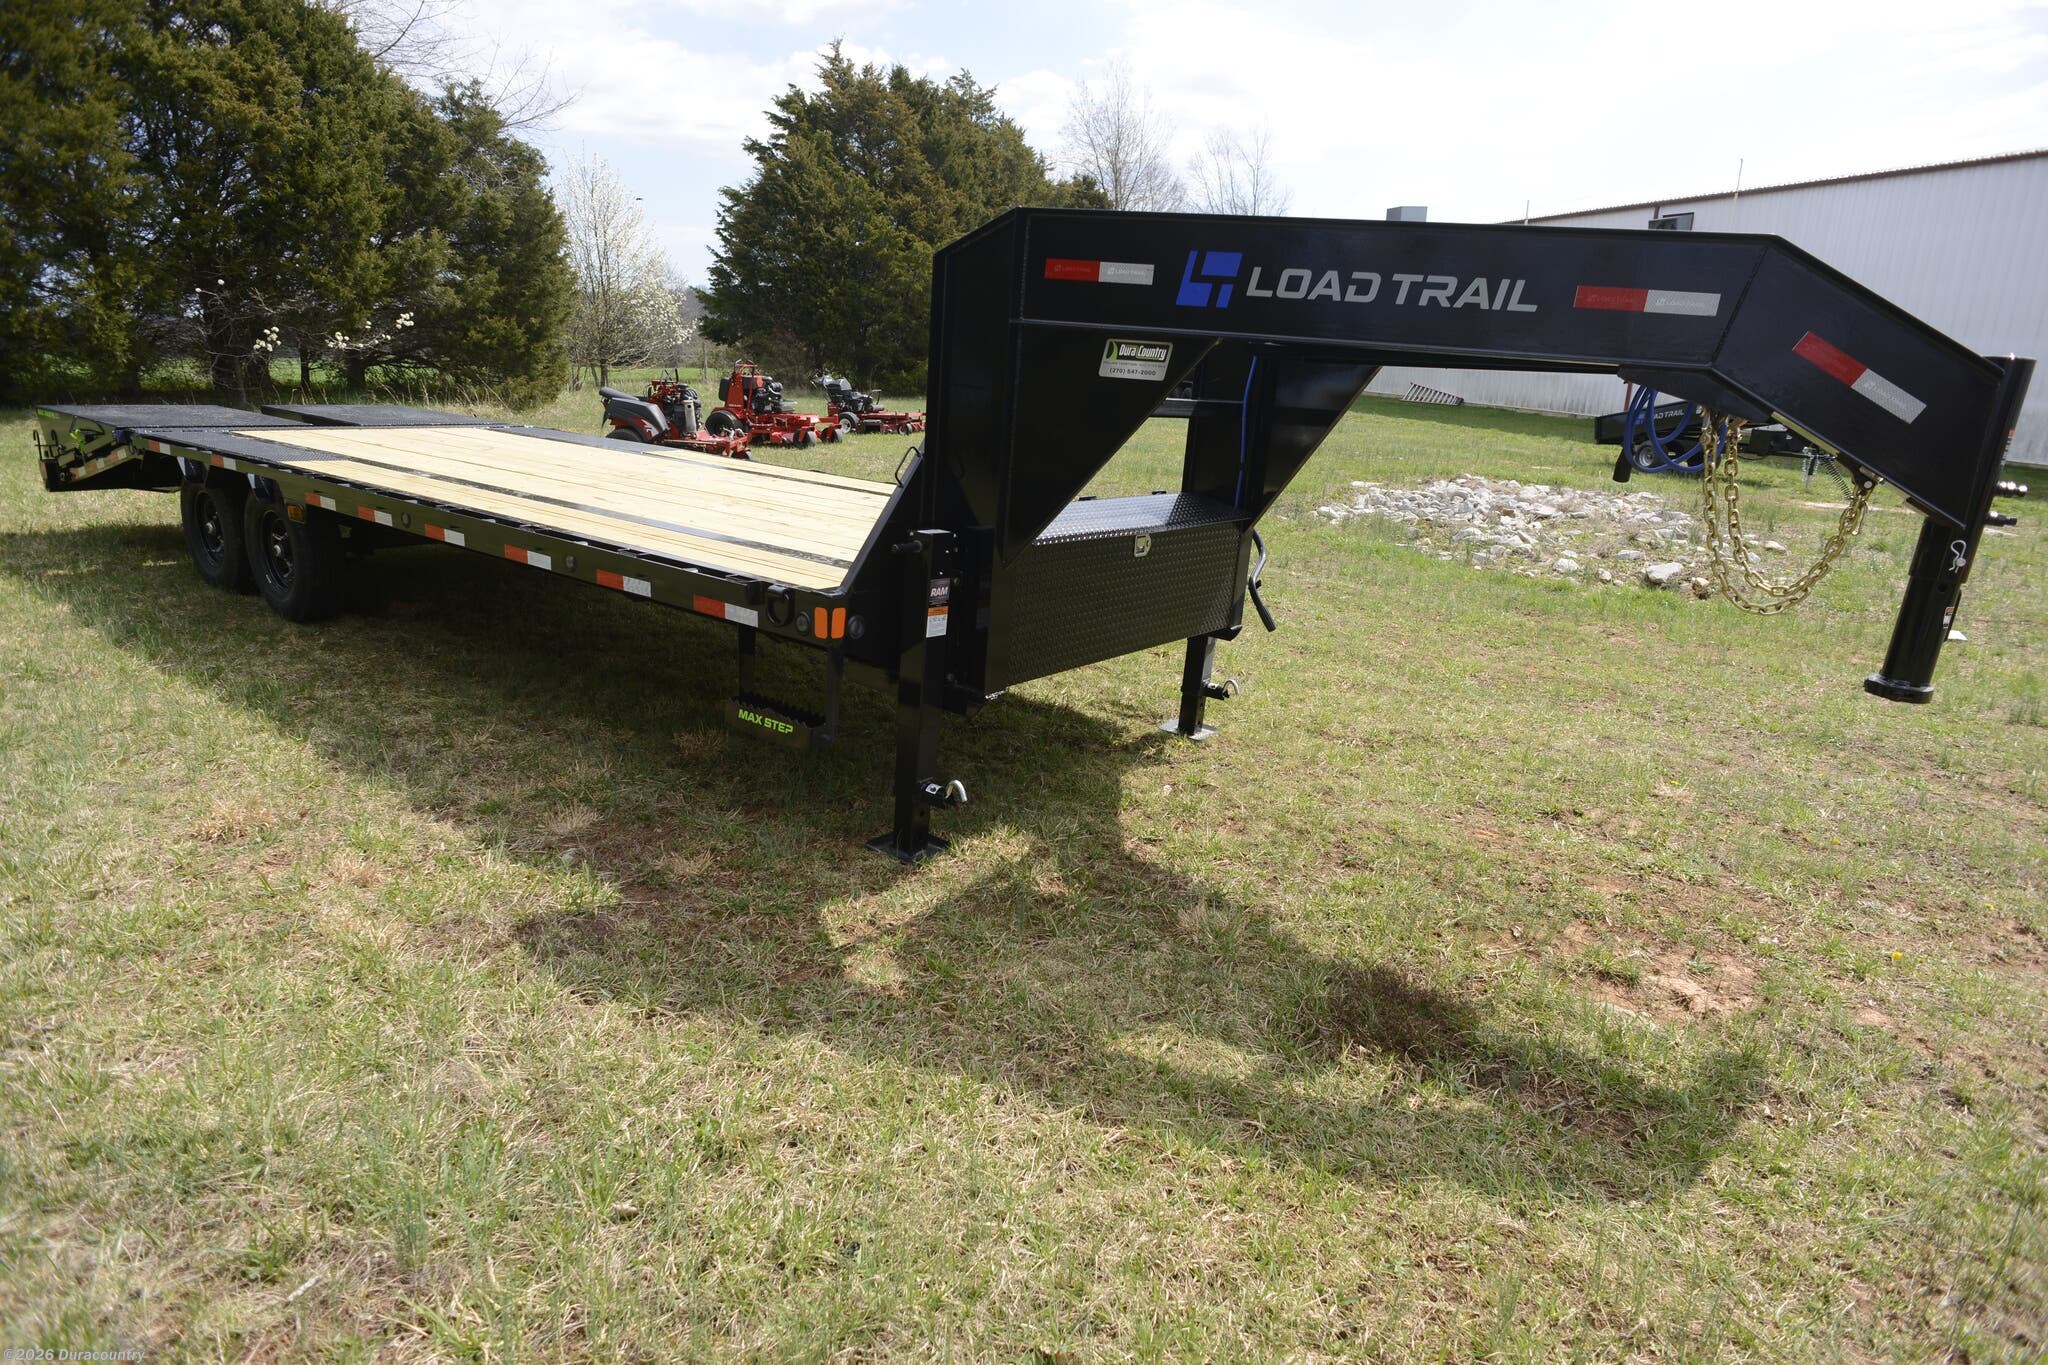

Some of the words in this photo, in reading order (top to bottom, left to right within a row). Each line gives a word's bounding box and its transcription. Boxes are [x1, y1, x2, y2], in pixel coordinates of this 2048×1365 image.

[1246, 266, 1381, 303] LOAD
[1392, 273, 1538, 312] TRAIL
[1119, 344, 1136, 356] Dura
[1137, 345, 1167, 360] Country
[1664, 409, 1684, 418] TRAIL
[930, 586, 948, 597] RAM
[738, 708, 762, 726] MAX
[763, 717, 794, 734] STEP
